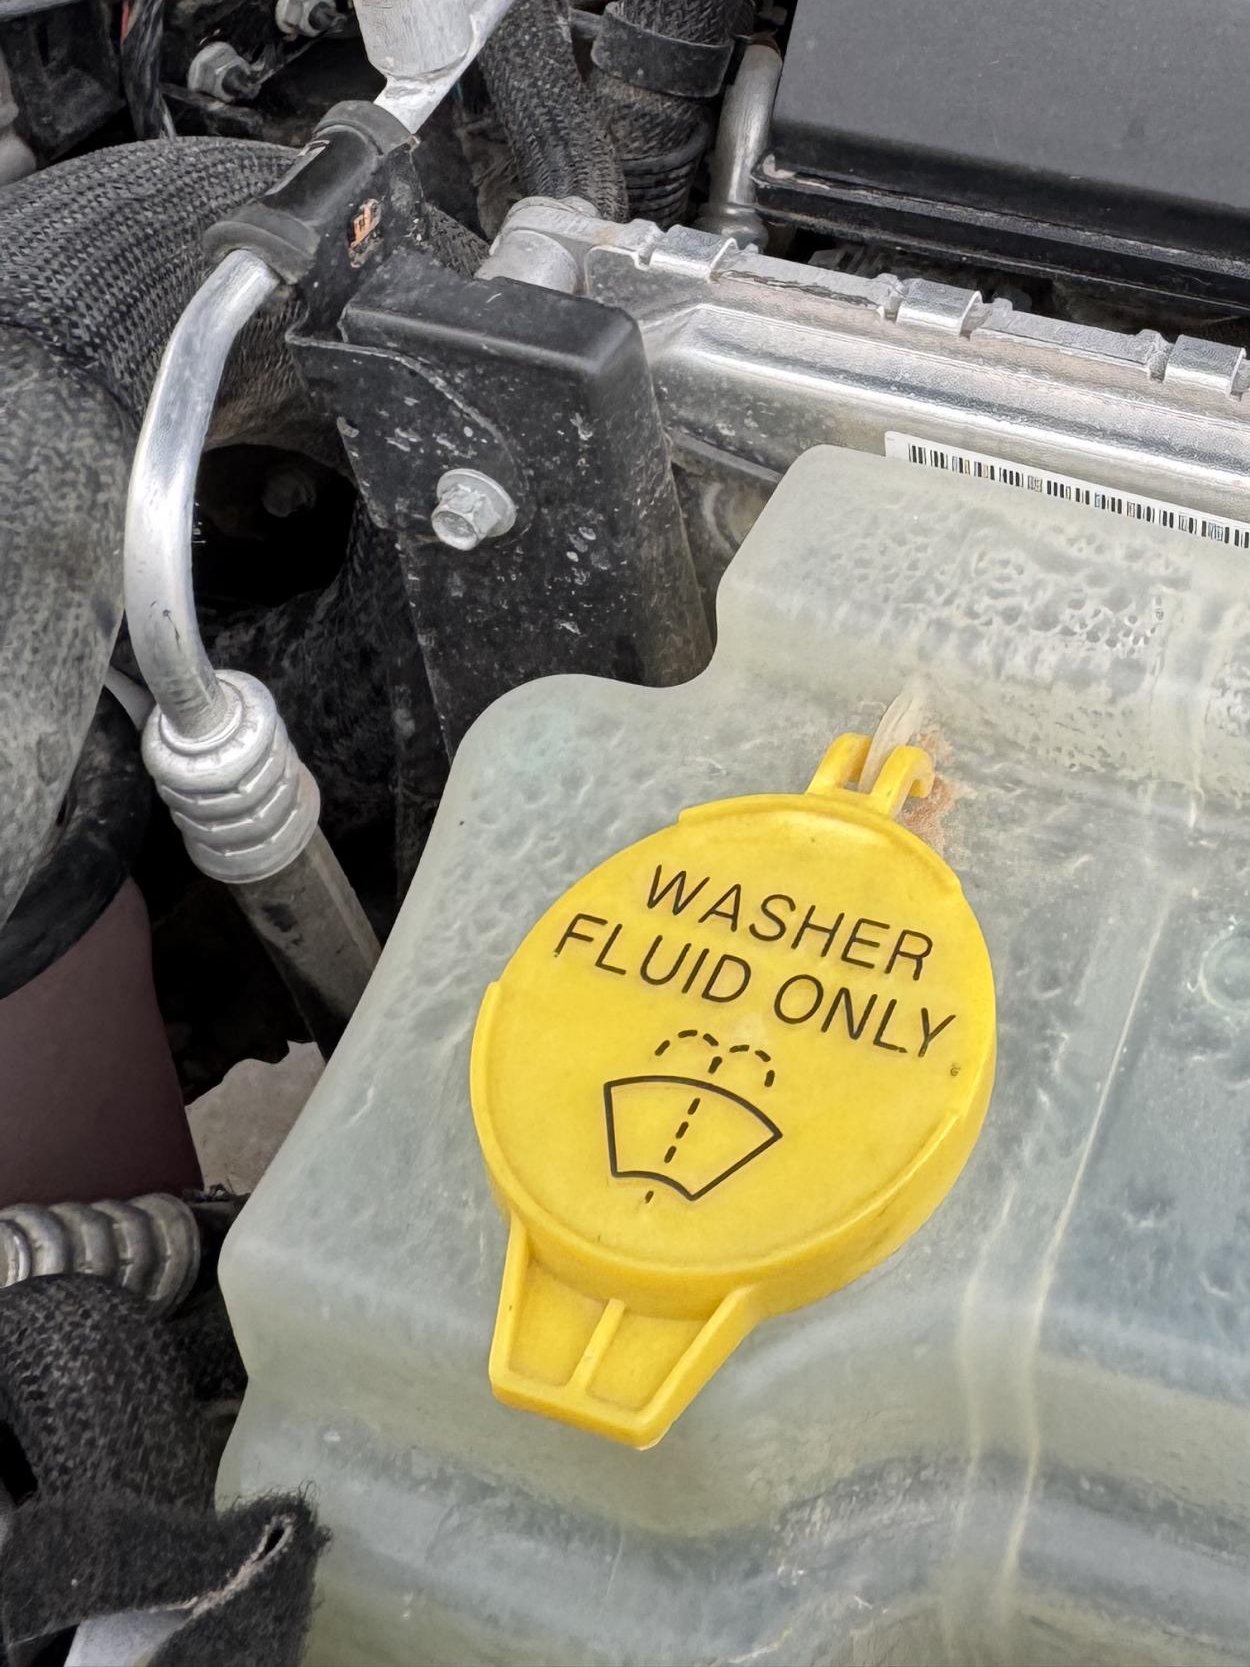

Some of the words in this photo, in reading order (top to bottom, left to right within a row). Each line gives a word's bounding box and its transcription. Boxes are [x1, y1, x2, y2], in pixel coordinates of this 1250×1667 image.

[553, 912, 753, 1004] FLUID
[773, 973, 957, 1058] ONLY
[646, 864, 934, 981] WASHER
